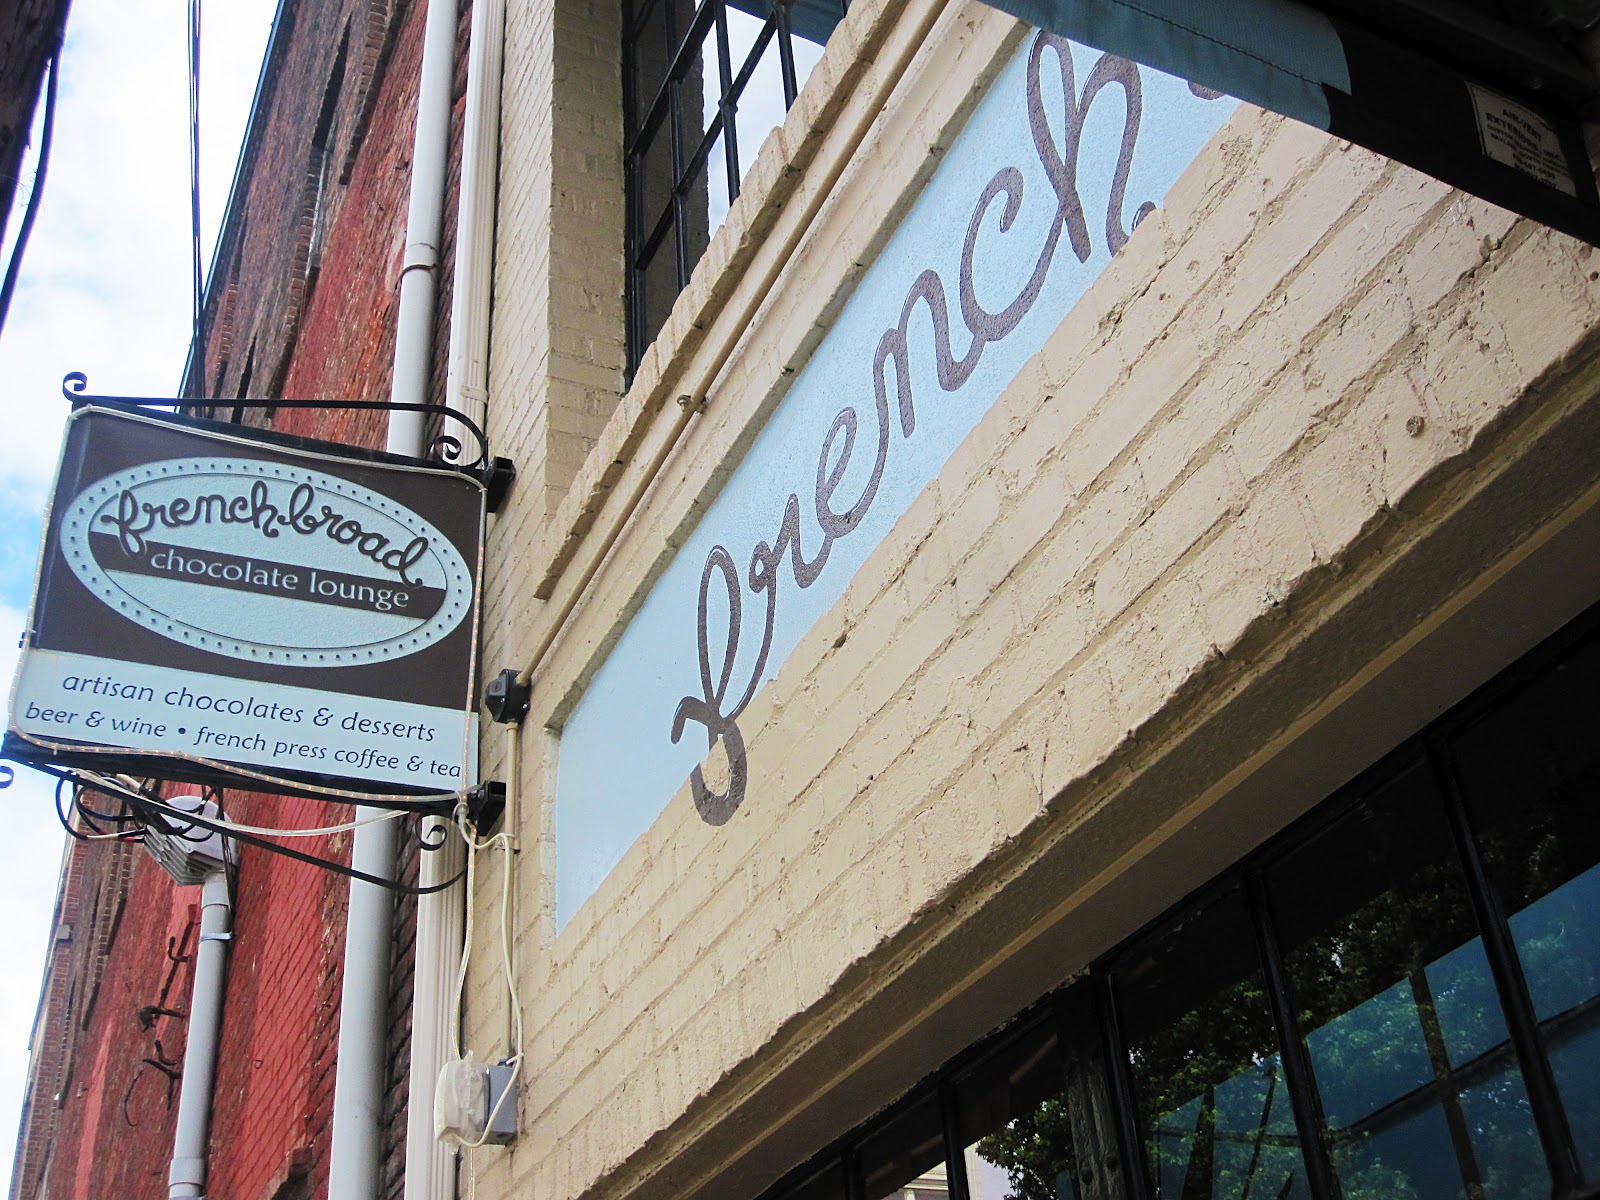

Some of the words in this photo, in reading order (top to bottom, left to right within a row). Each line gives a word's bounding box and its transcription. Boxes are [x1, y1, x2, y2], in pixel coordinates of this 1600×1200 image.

[669, 29, 1157, 827] french
[100, 480, 280, 558] french
[276, 483, 429, 588] broad
[150, 548, 299, 590] chocolate
[309, 571, 410, 611] lounge
[25, 702, 78, 724] beer
[85, 711, 105, 728] &
[111, 717, 167, 738] wine
[193, 725, 267, 751] french
[272, 741, 327, 759] press
[334, 748, 399, 769] coffee
[406, 755, 424, 772] &
[430, 759, 462, 778] tea
[62, 675, 154, 702] artisan
[164, 687, 304, 723] chocolates
[313, 707, 334, 727] &
[341, 711, 436, 742] desserts
